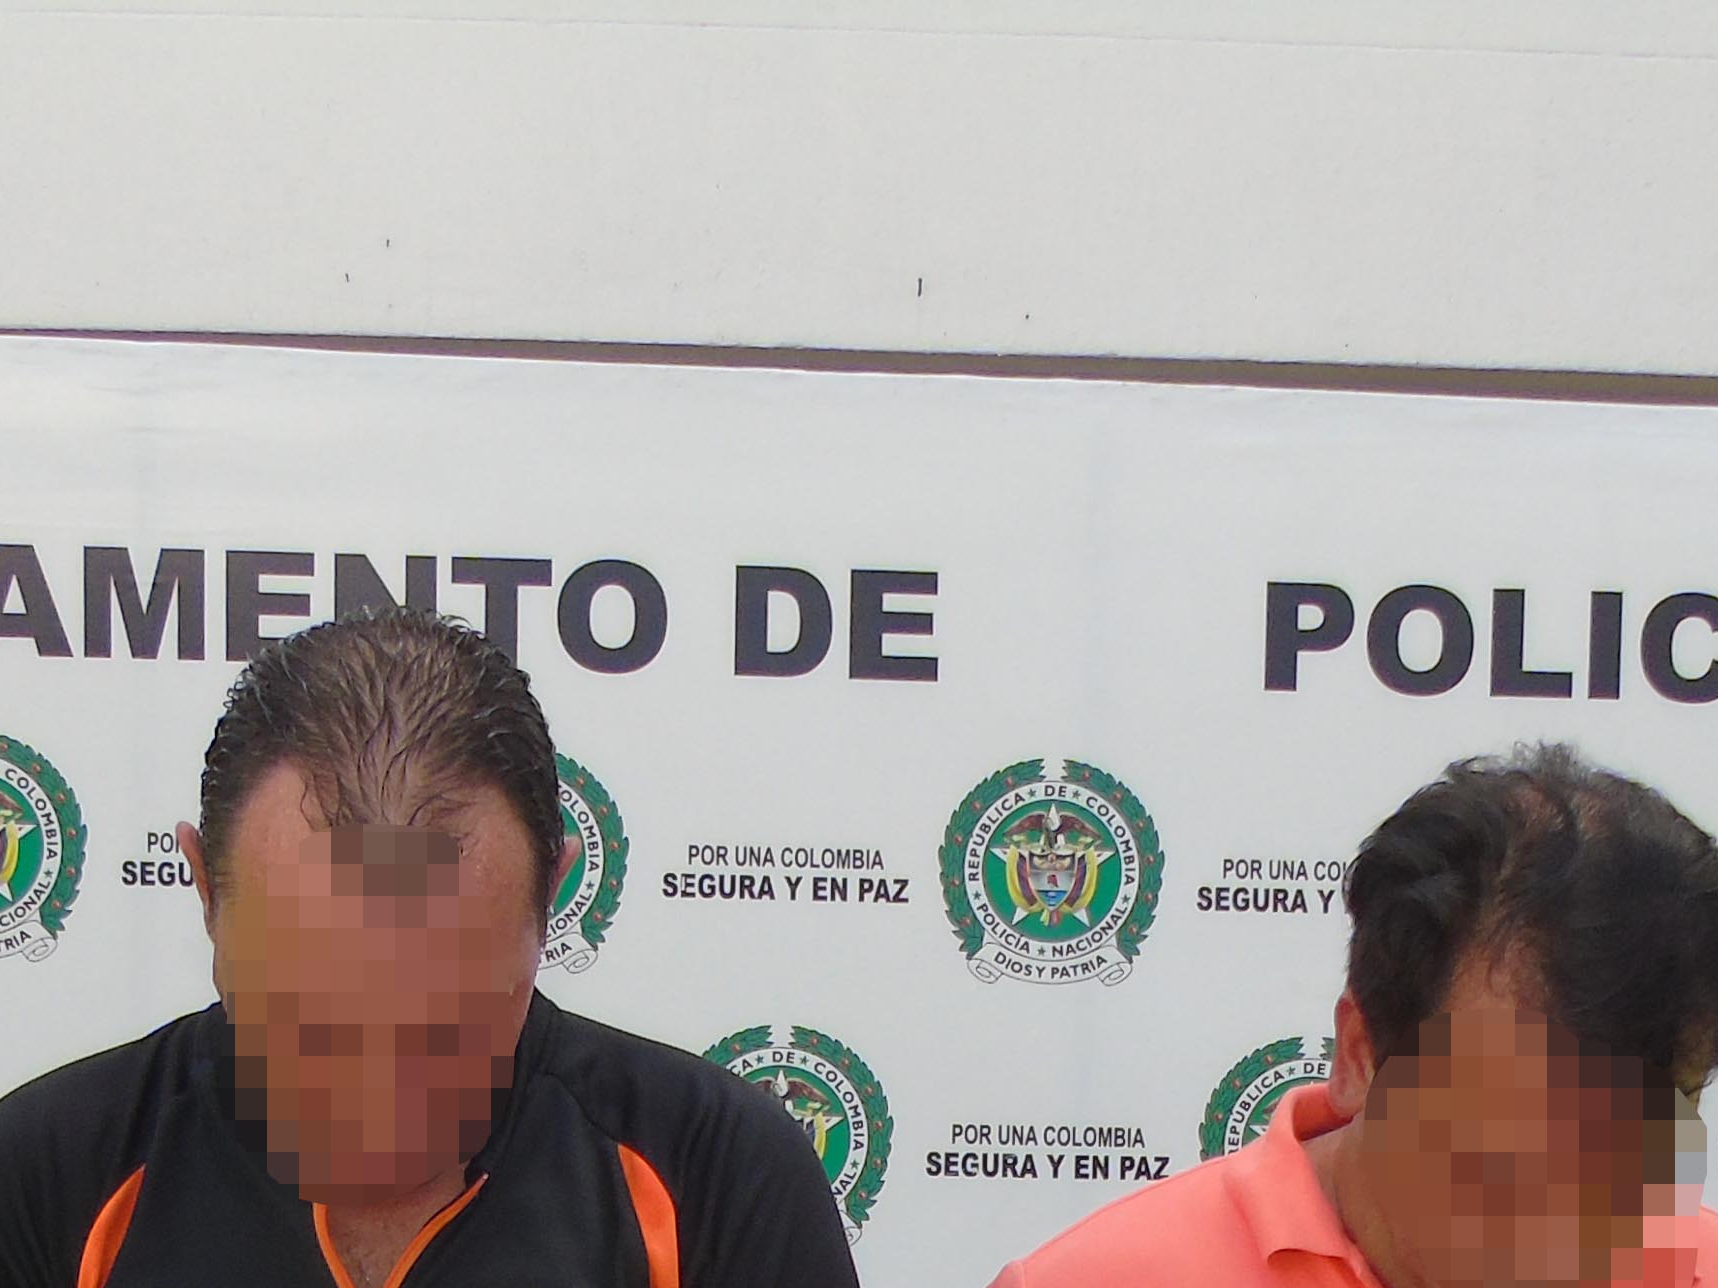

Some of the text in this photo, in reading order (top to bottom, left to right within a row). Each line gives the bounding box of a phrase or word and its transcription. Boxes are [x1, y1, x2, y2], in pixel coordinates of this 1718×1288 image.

[734, 564, 940, 682] DE
[4, 768, 58, 860] COLOMBIA
[561, 788, 600, 872] OLOMBIA
[1044, 785, 1067, 798] DE
[1085, 796, 1136, 886] COLOMBIA
[688, 844, 885, 870] POR UNA COLOMBIA
[1223, 858, 1263, 880] POR
[1269, 860, 1308, 881] UNA
[121, 860, 194, 887] SEGU
[662, 873, 910, 903] SEGURA Y EN PAZ
[1197, 886, 1336, 914] SEGURA Y
[547, 893, 592, 938] IONAL
[1051, 904, 1128, 958] NACIONAL
[993, 951, 1109, 980] DIOS Y PATRIA
[1303, 1063, 1327, 1075] DE
[772, 1050, 865, 1152] DE COLOMBIA
[951, 1123, 1145, 1148] POR UNA COLOMBIA
[925, 1151, 1170, 1180] SEGURA Y EN PAZ
